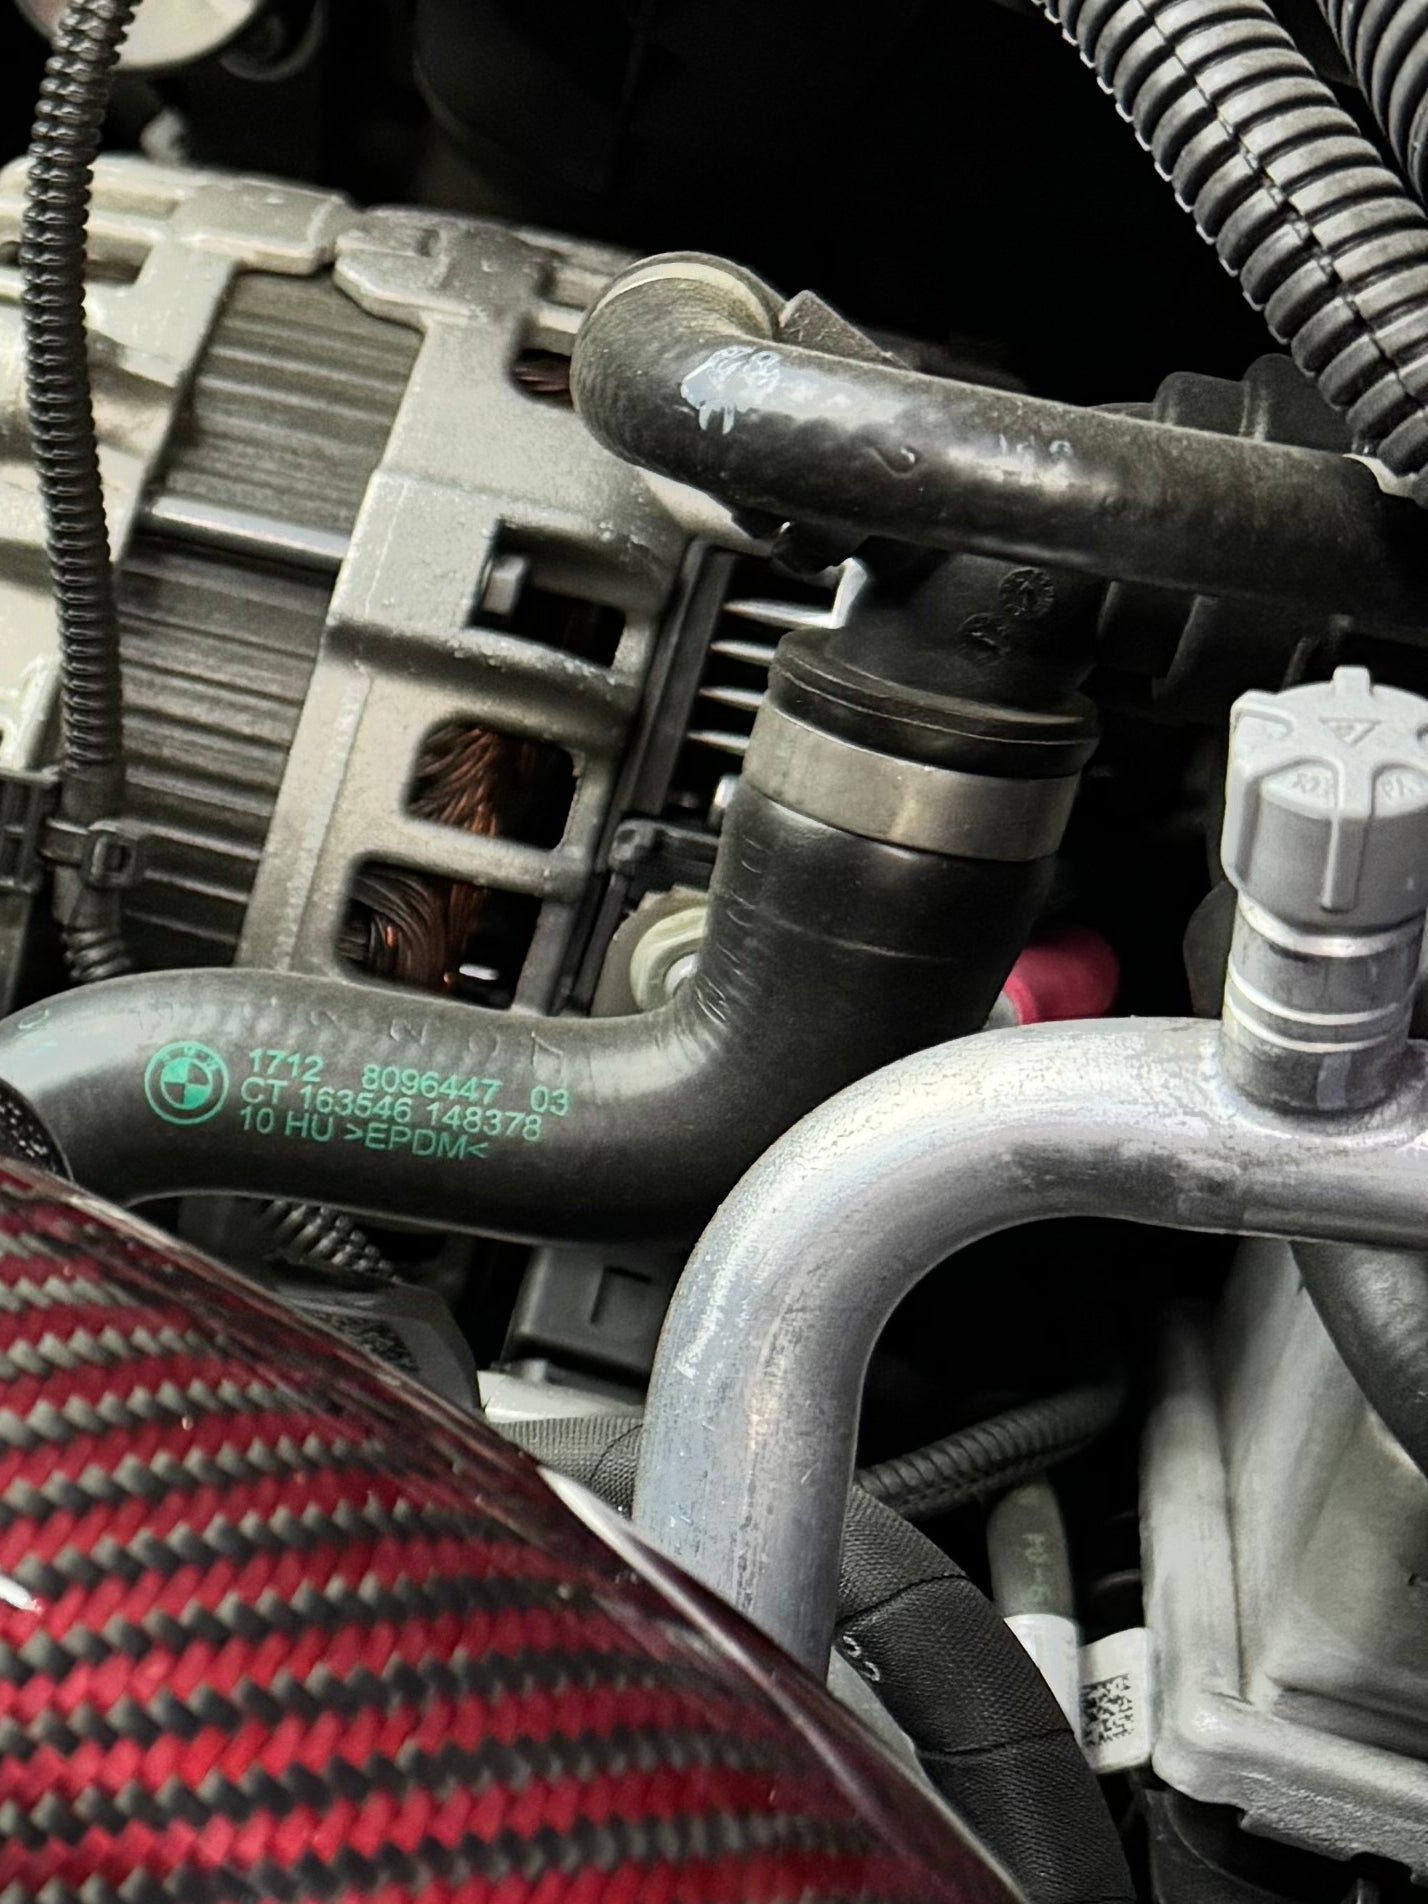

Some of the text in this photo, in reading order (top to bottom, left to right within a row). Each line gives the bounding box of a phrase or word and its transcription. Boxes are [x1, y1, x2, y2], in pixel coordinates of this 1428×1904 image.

[240, 1076, 543, 1142] CT 163546 148378
[249, 1047, 569, 1117] 1712 8096447 03
[240, 1105, 489, 1161] 10 HU >EPDM<
